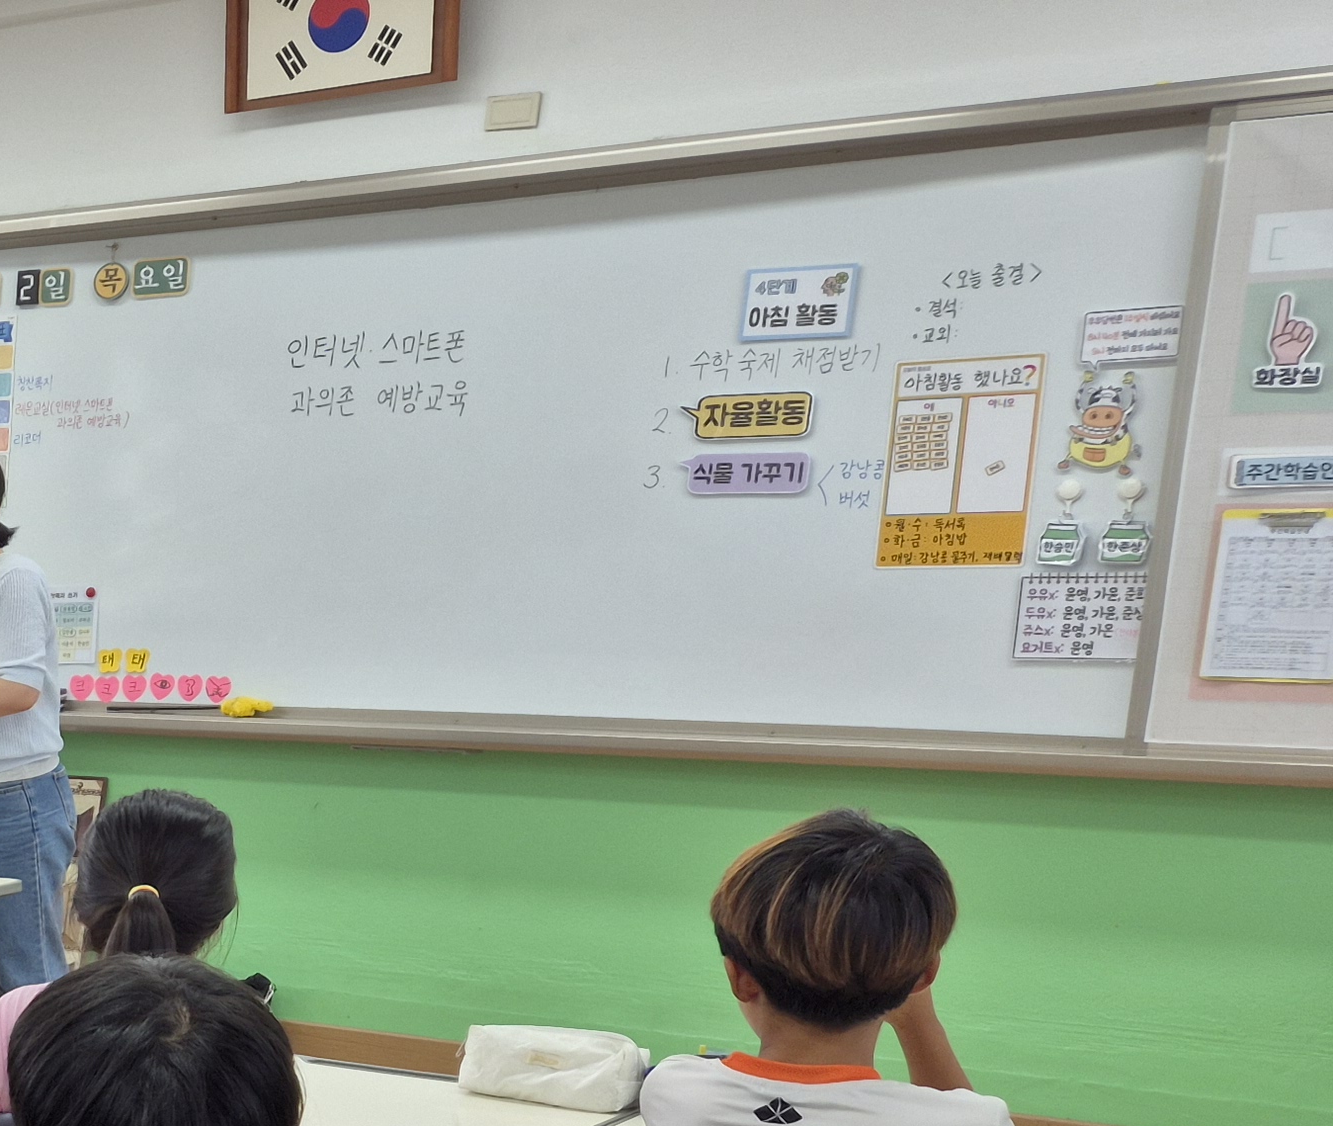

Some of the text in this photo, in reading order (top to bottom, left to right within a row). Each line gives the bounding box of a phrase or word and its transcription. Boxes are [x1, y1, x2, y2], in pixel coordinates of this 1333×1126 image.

[748, 303, 838, 329] 아침 활동
[1253, 366, 1321, 387] 화장실
[290, 379, 469, 417] 과의존 예방교육
[703, 398, 806, 428] 자율활동
[692, 461, 805, 485] 식물 가꾸기
[101, 652, 146, 669] 태 태
